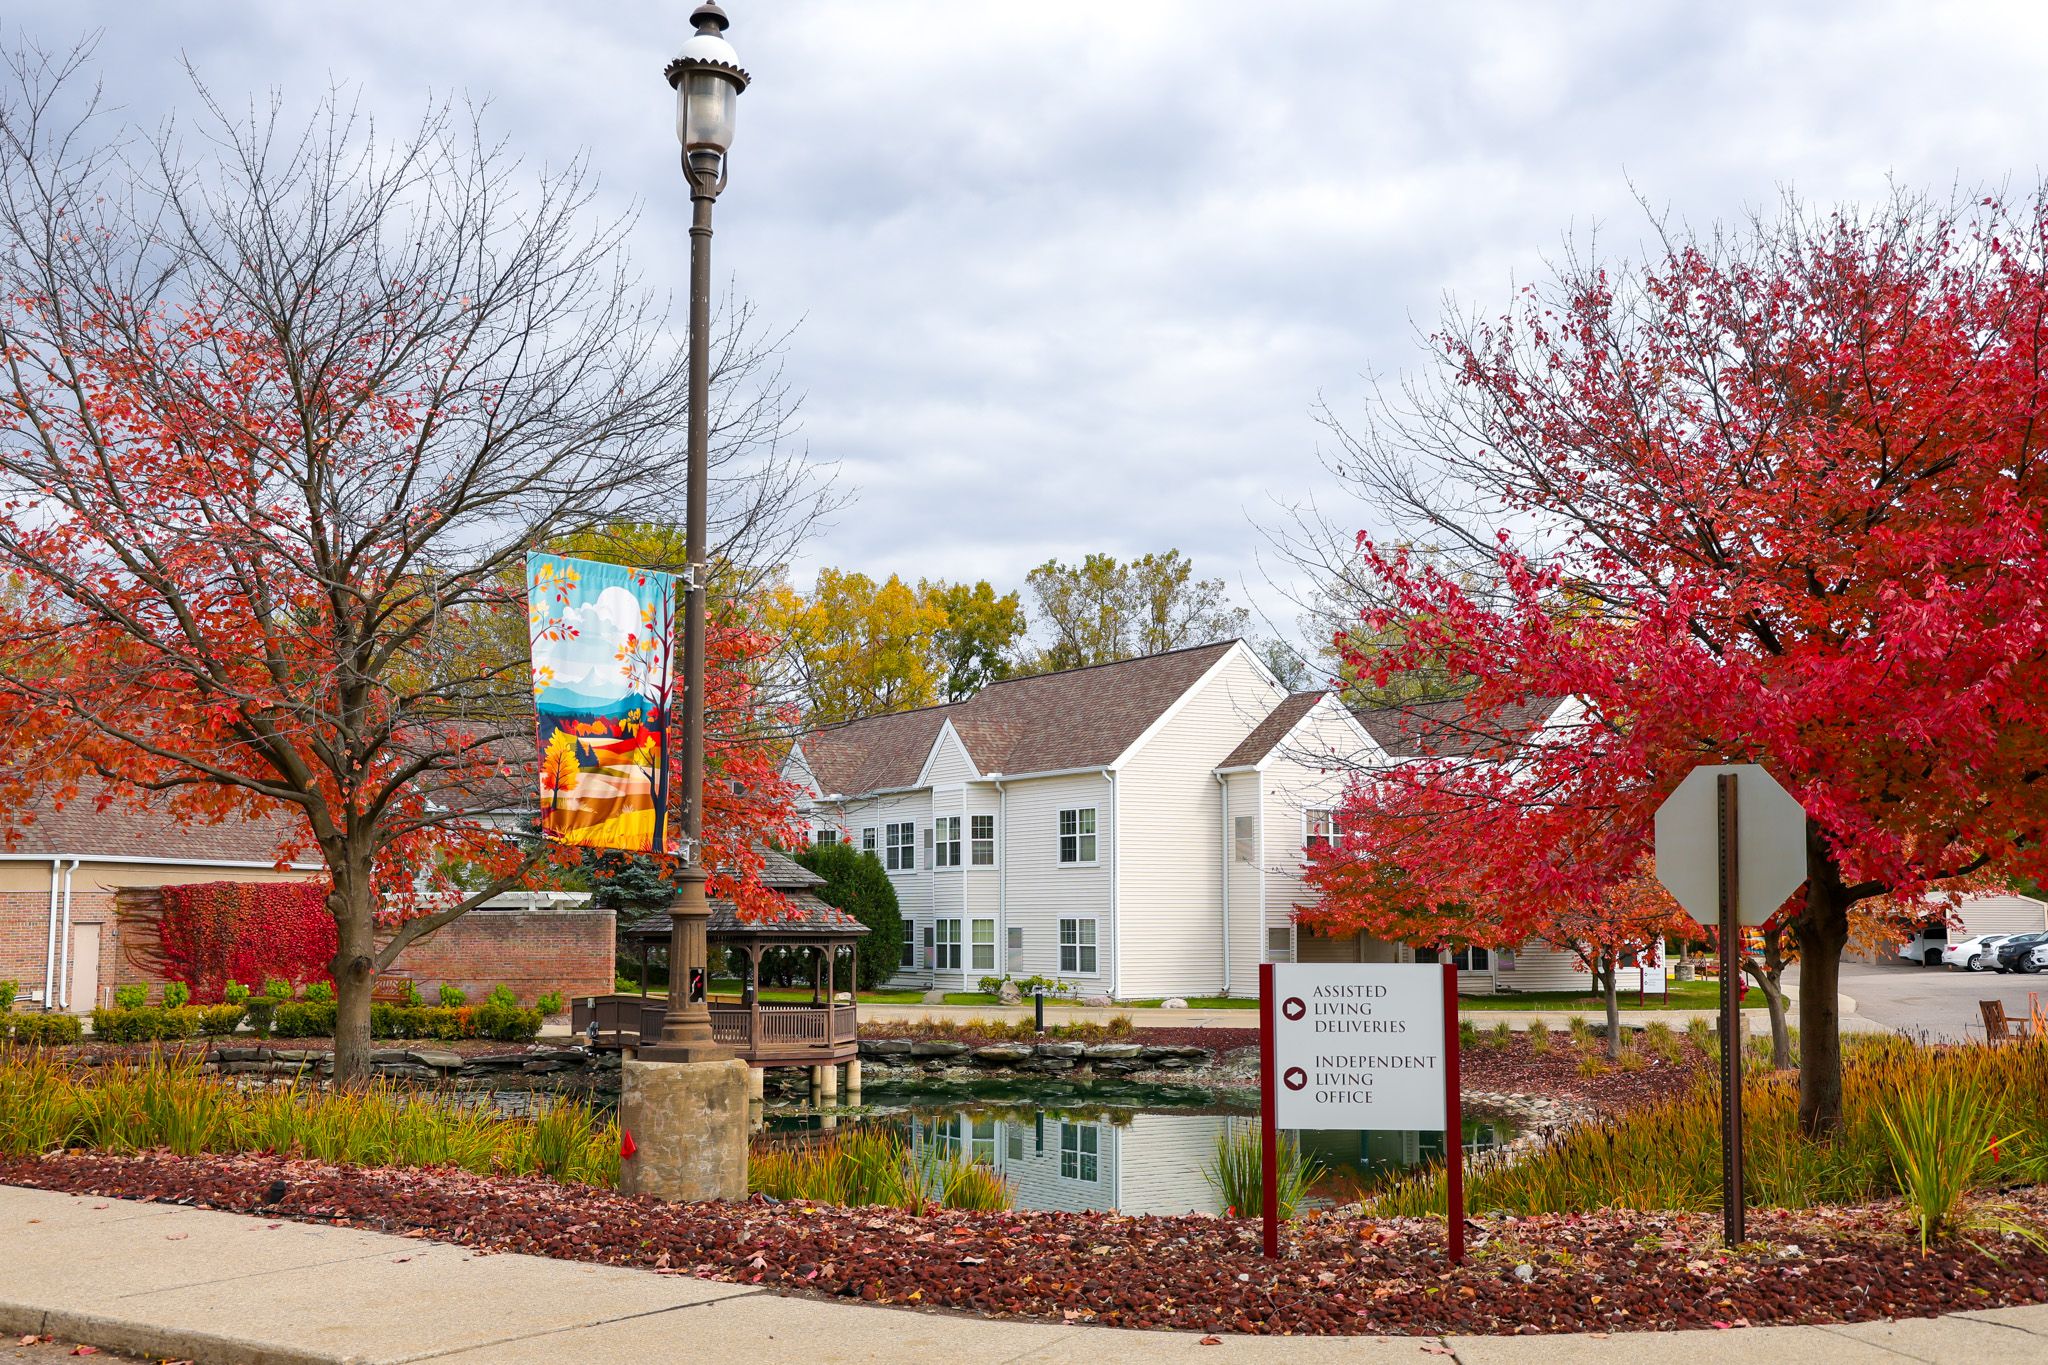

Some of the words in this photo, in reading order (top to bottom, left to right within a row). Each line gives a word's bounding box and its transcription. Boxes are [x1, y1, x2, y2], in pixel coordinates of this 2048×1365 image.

[1313, 985, 1387, 998] ASSISTED
[1314, 1003, 1372, 1015] LIVING
[1315, 1020, 1406, 1033] DELIVERIES
[1315, 1055, 1437, 1069] INDEPENDENT
[1316, 1073, 1373, 1086] LIVING
[1315, 1090, 1373, 1103] OFFICE
